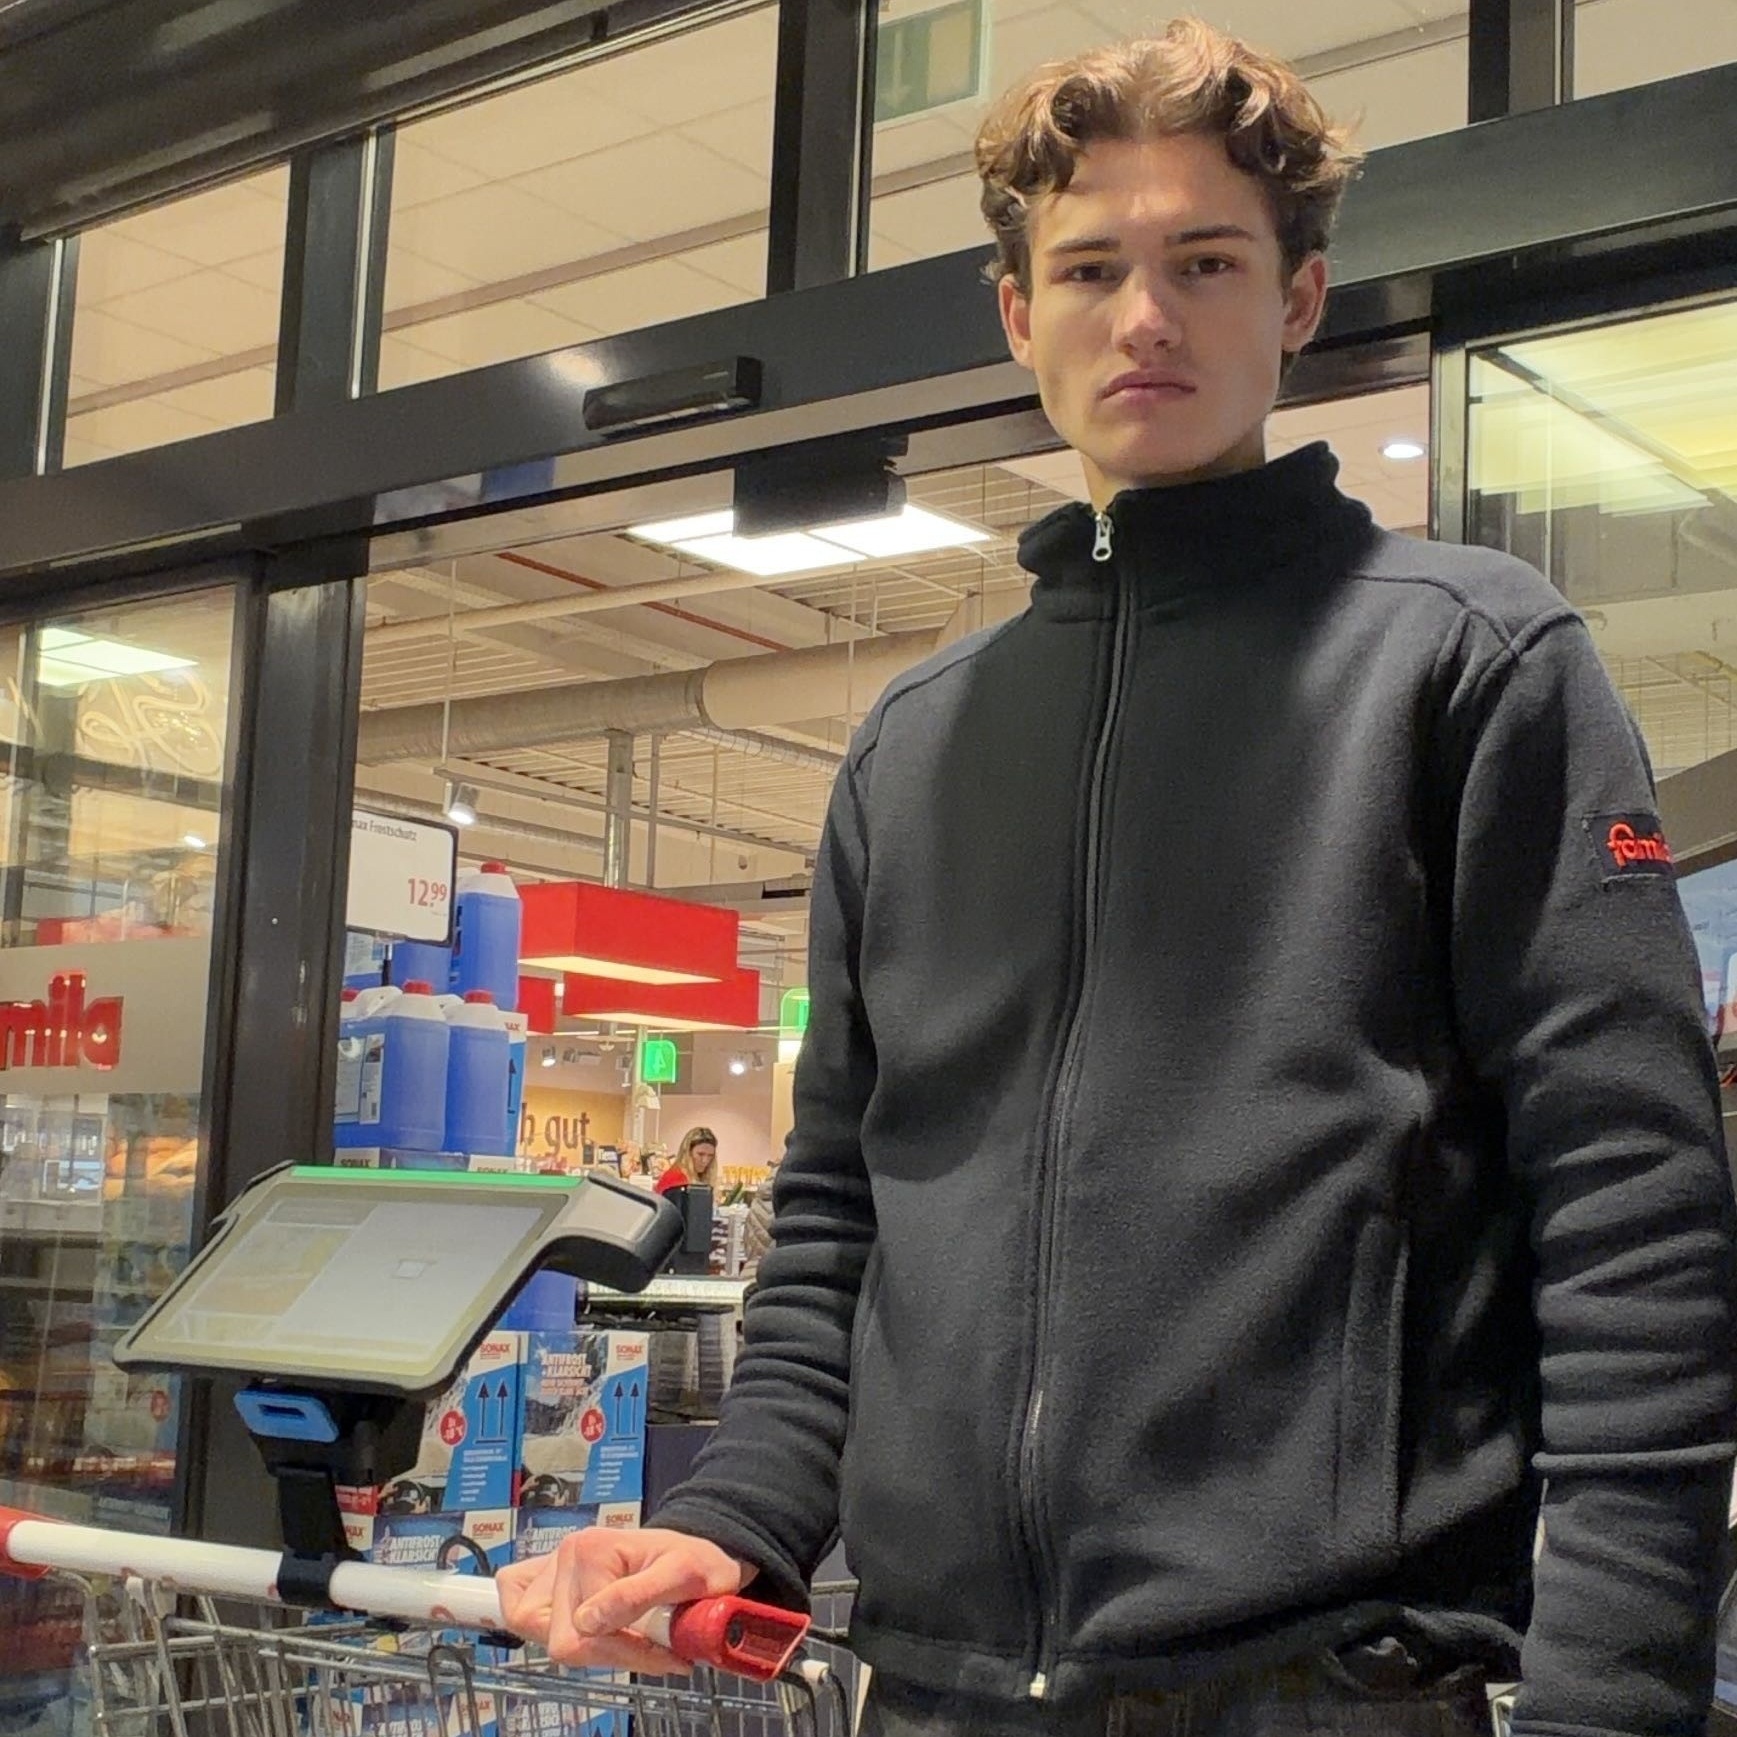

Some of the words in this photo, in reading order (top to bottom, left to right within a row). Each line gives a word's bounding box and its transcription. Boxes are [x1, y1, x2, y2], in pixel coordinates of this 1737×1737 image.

[545, 1112, 590, 1158] gut
[480, 1342, 512, 1354] SONAX
[616, 1344, 643, 1354] SONAX
[606, 1513, 634, 1525] SONAX
[472, 1522, 504, 1533] SONAX
